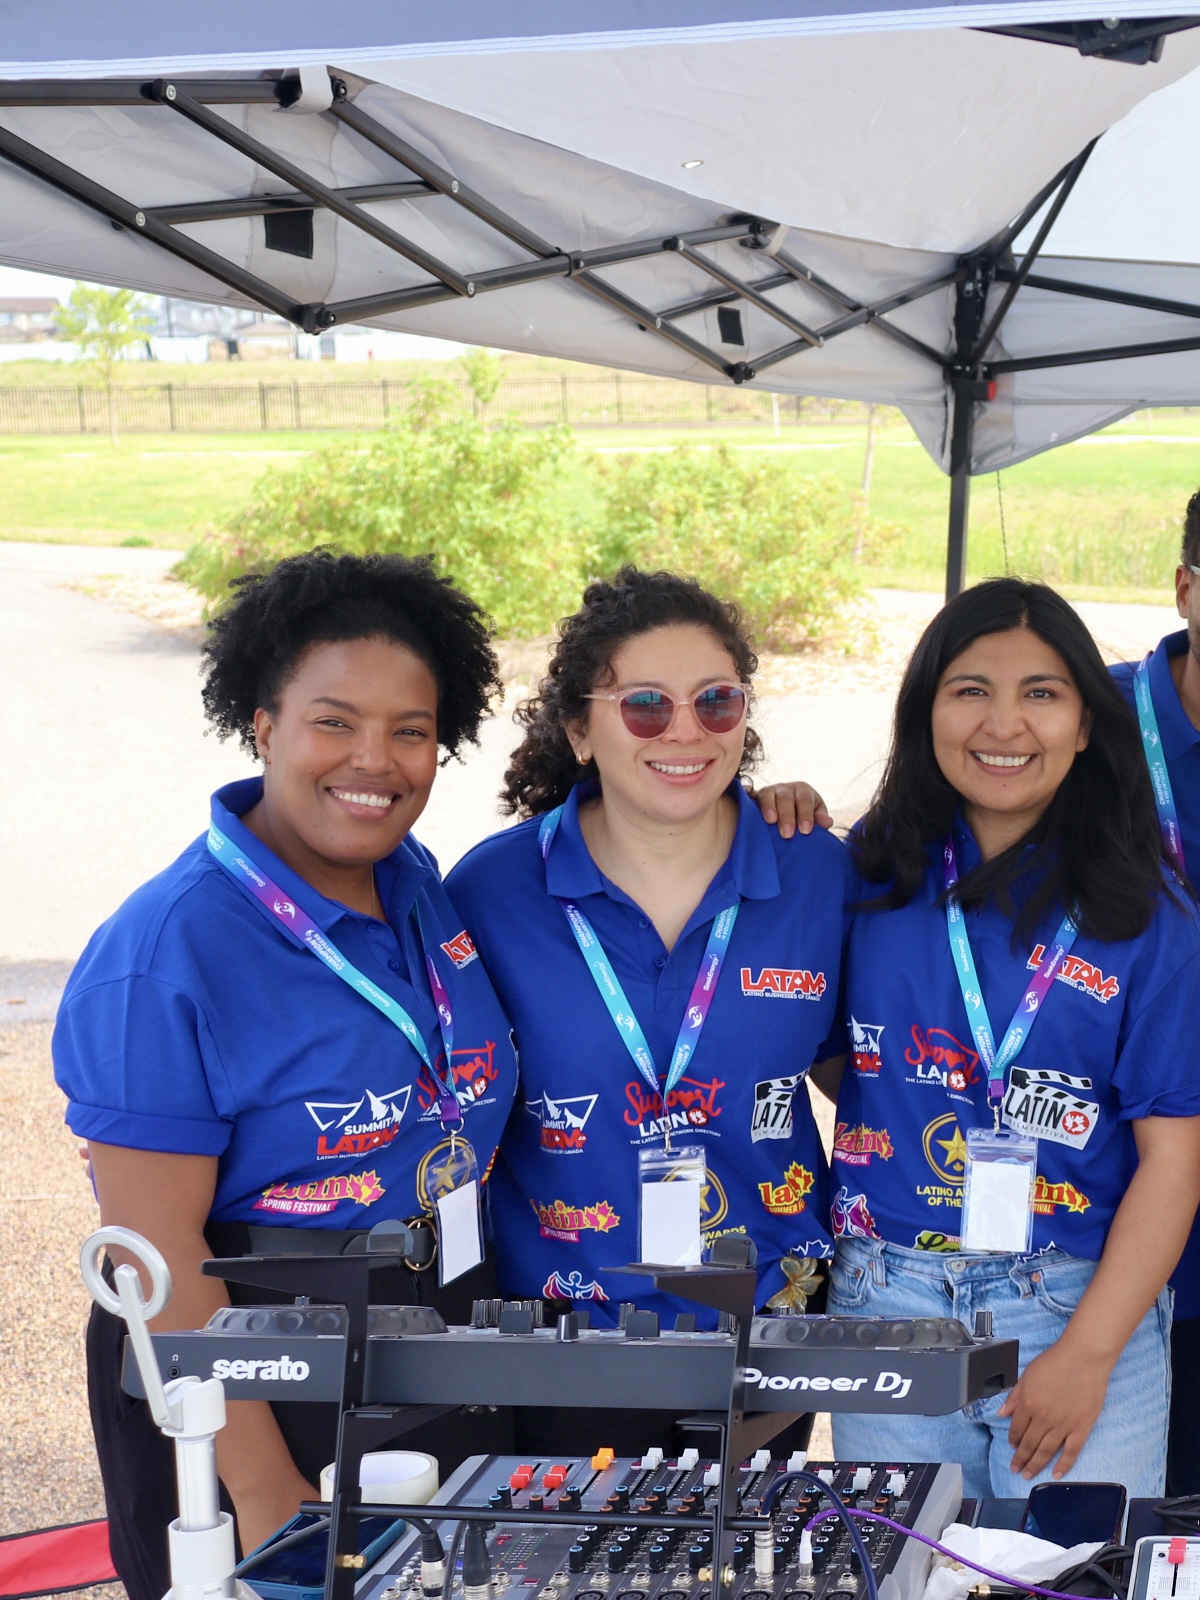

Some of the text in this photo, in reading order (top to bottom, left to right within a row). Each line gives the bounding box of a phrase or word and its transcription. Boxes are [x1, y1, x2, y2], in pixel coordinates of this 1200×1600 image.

[714, 909, 729, 938] CHAMP
[741, 968, 824, 997] LATAM
[1086, 988, 1107, 1004] CANADA
[344, 1117, 392, 1136] SUMMIT
[1009, 1118, 1070, 1141] FILM FESTIVAL
[917, 1185, 952, 1197] LATINO
[262, 1199, 331, 1212] SPRING FESTIVAL
[769, 1205, 798, 1214] SUMMER
[928, 1197, 962, 1208] OF THE
[212, 1355, 310, 1381] serato
[744, 1367, 868, 1391] Pioneer
